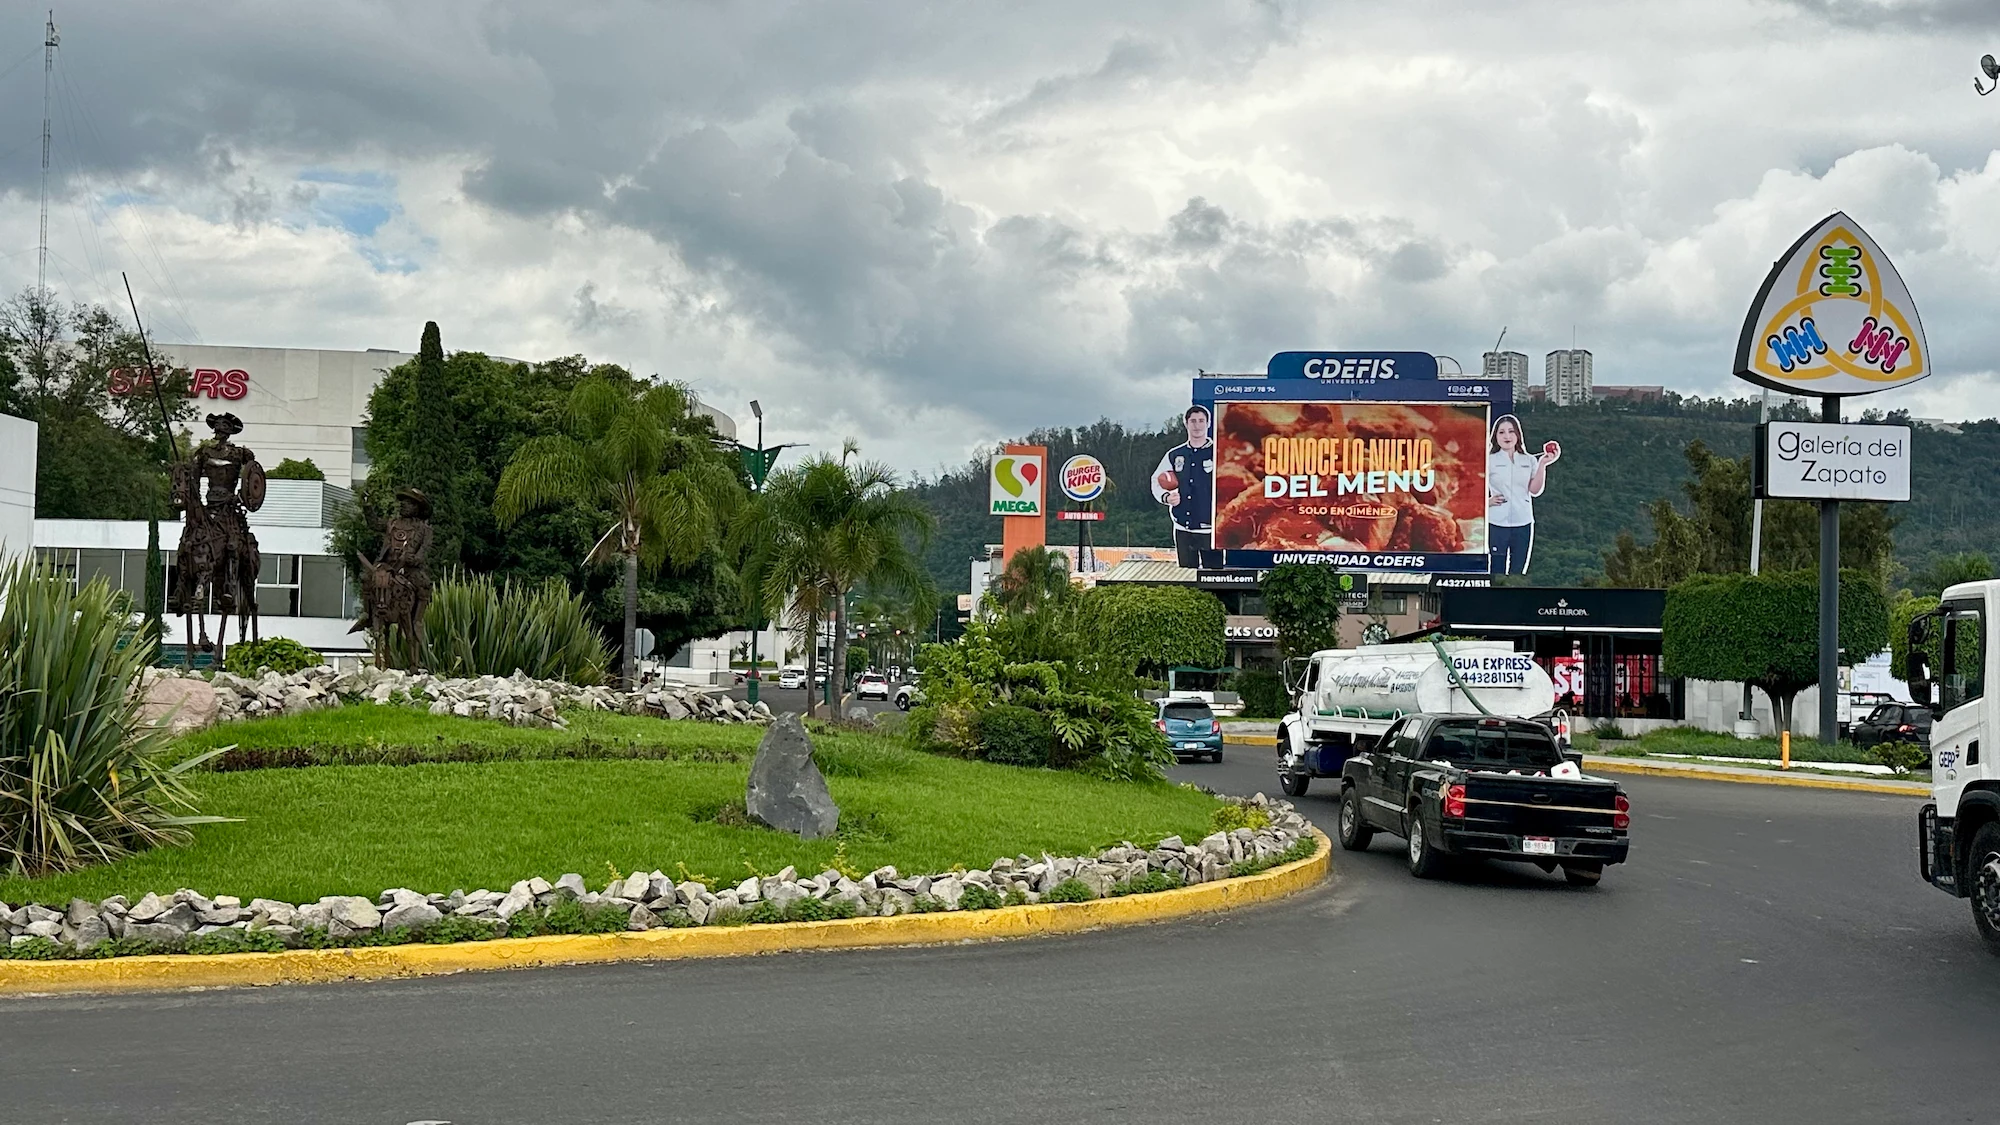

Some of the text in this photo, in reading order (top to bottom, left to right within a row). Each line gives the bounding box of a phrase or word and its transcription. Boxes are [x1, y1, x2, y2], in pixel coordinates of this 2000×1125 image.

[1303, 358, 1395, 380] CDEFIS
[1868, 438, 1902, 458] del
[1264, 437, 1433, 476] CONOCE LO NUEVO
[1067, 465, 1100, 478] BURGER
[1801, 460, 1886, 487] Zapato
[1067, 473, 1102, 489] KING
[1264, 463, 1435, 499] DEL MENÚ
[992, 500, 1038, 513] MEGA
[1299, 506, 1328, 516] SOLO
[1330, 506, 1346, 516] EN
[1273, 553, 1425, 568] UNIVERSIDAD CDEFIS
[1201, 575, 1254, 583] naranti.com
[1537, 607, 1558, 616] CAFÉ
[1224, 626, 1251, 637] CKS
[1483, 658, 1532, 671] EXPRESS
[1461, 672, 1524, 684] 4432811514
